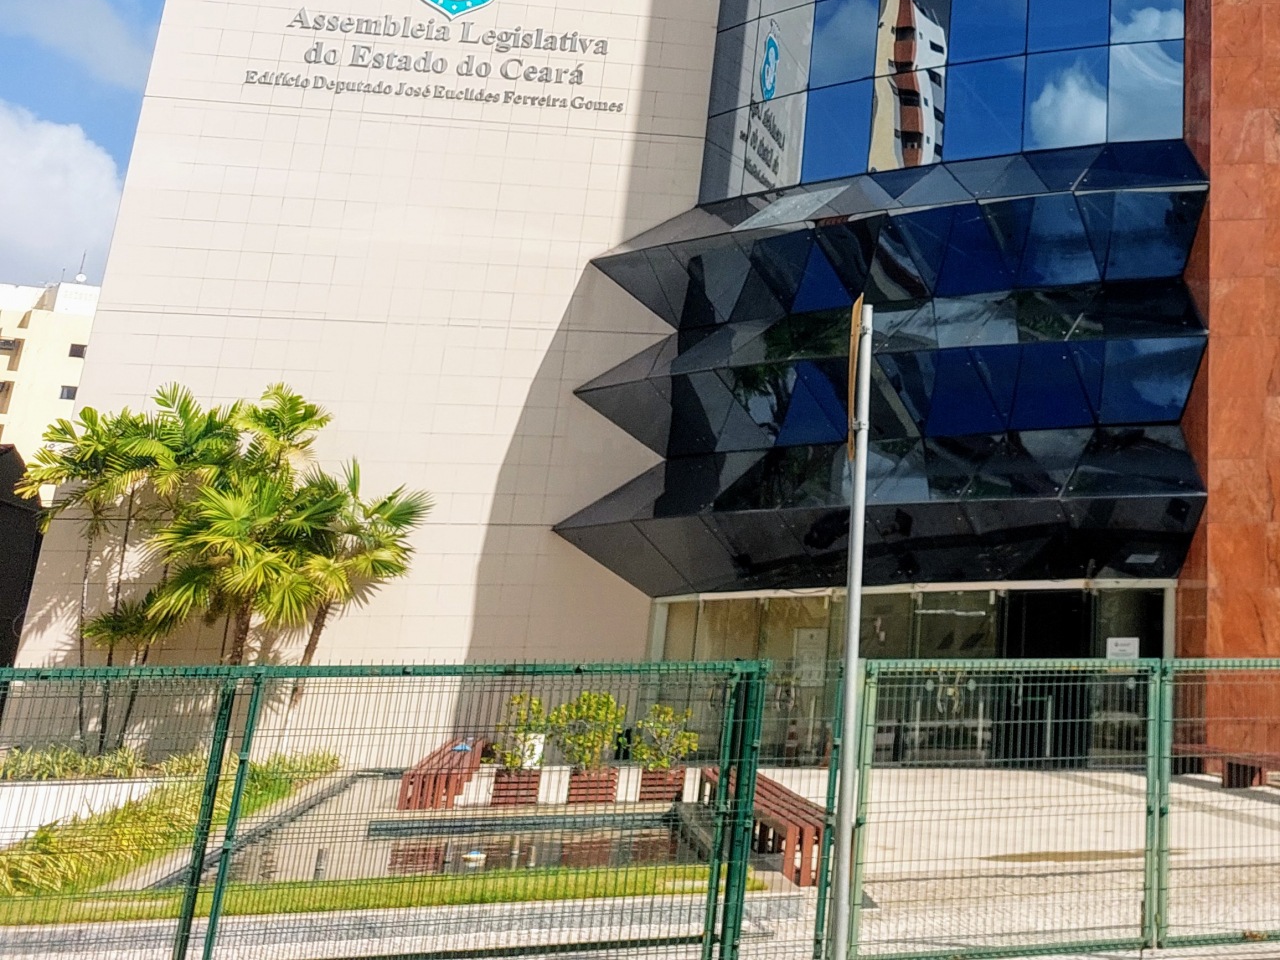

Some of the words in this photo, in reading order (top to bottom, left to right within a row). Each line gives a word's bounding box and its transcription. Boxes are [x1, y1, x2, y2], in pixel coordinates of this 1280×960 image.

[286, 7, 451, 41] Assembleia
[458, 21, 609, 55] Legislativa
[304, 42, 341, 65] do
[348, 44, 448, 74] Estado
[456, 55, 492, 78] do
[500, 58, 585, 85] Ceará
[245, 70, 310, 89] Edifício
[312, 75, 393, 95] Deputado
[394, 82, 431, 98] José
[433, 85, 500, 103] Euclides
[503, 90, 568, 108] Ferreira
[570, 96, 625, 113] Gomes
